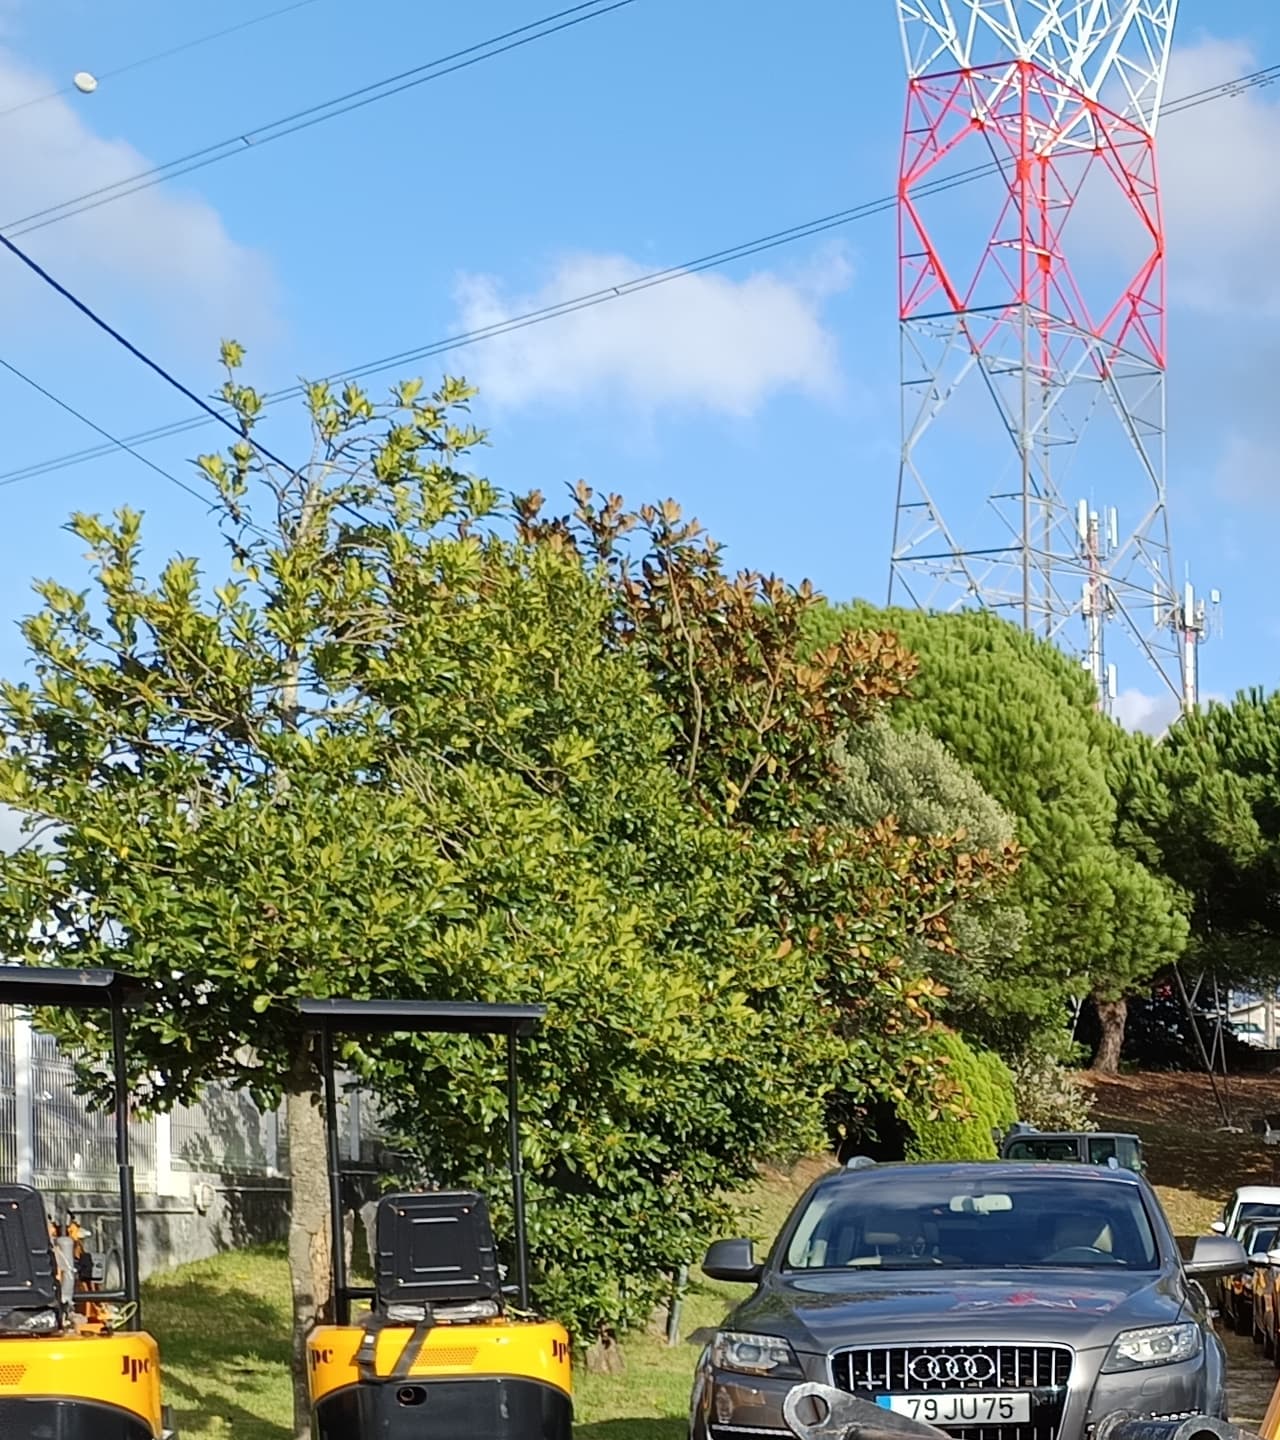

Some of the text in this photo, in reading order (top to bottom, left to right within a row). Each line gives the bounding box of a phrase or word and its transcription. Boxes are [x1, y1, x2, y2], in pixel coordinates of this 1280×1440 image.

[907, 1397, 1014, 1421] 79 JU 75
